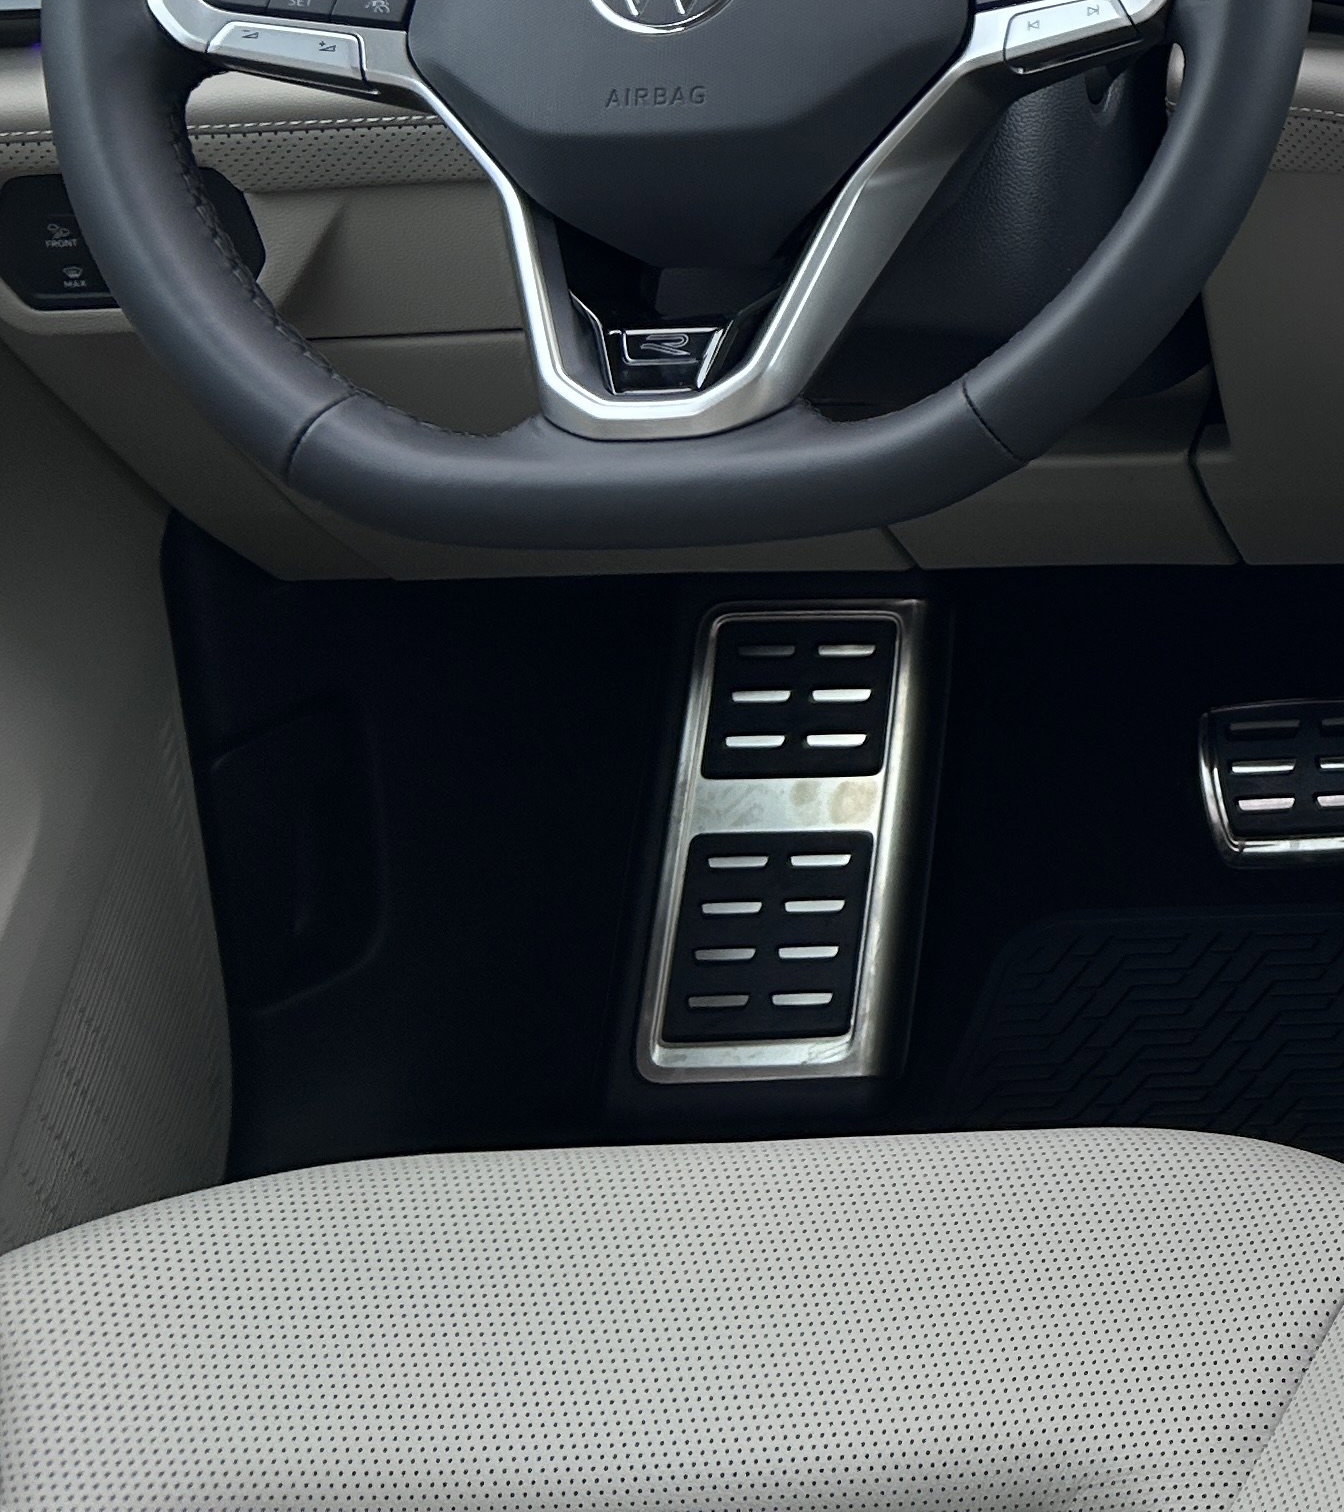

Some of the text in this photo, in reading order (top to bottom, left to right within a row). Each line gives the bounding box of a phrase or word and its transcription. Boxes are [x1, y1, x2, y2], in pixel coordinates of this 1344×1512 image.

[605, 85, 707, 109] AIRBAG
[45, 238, 78, 248] FRONT
[63, 279, 87, 288] MAX
